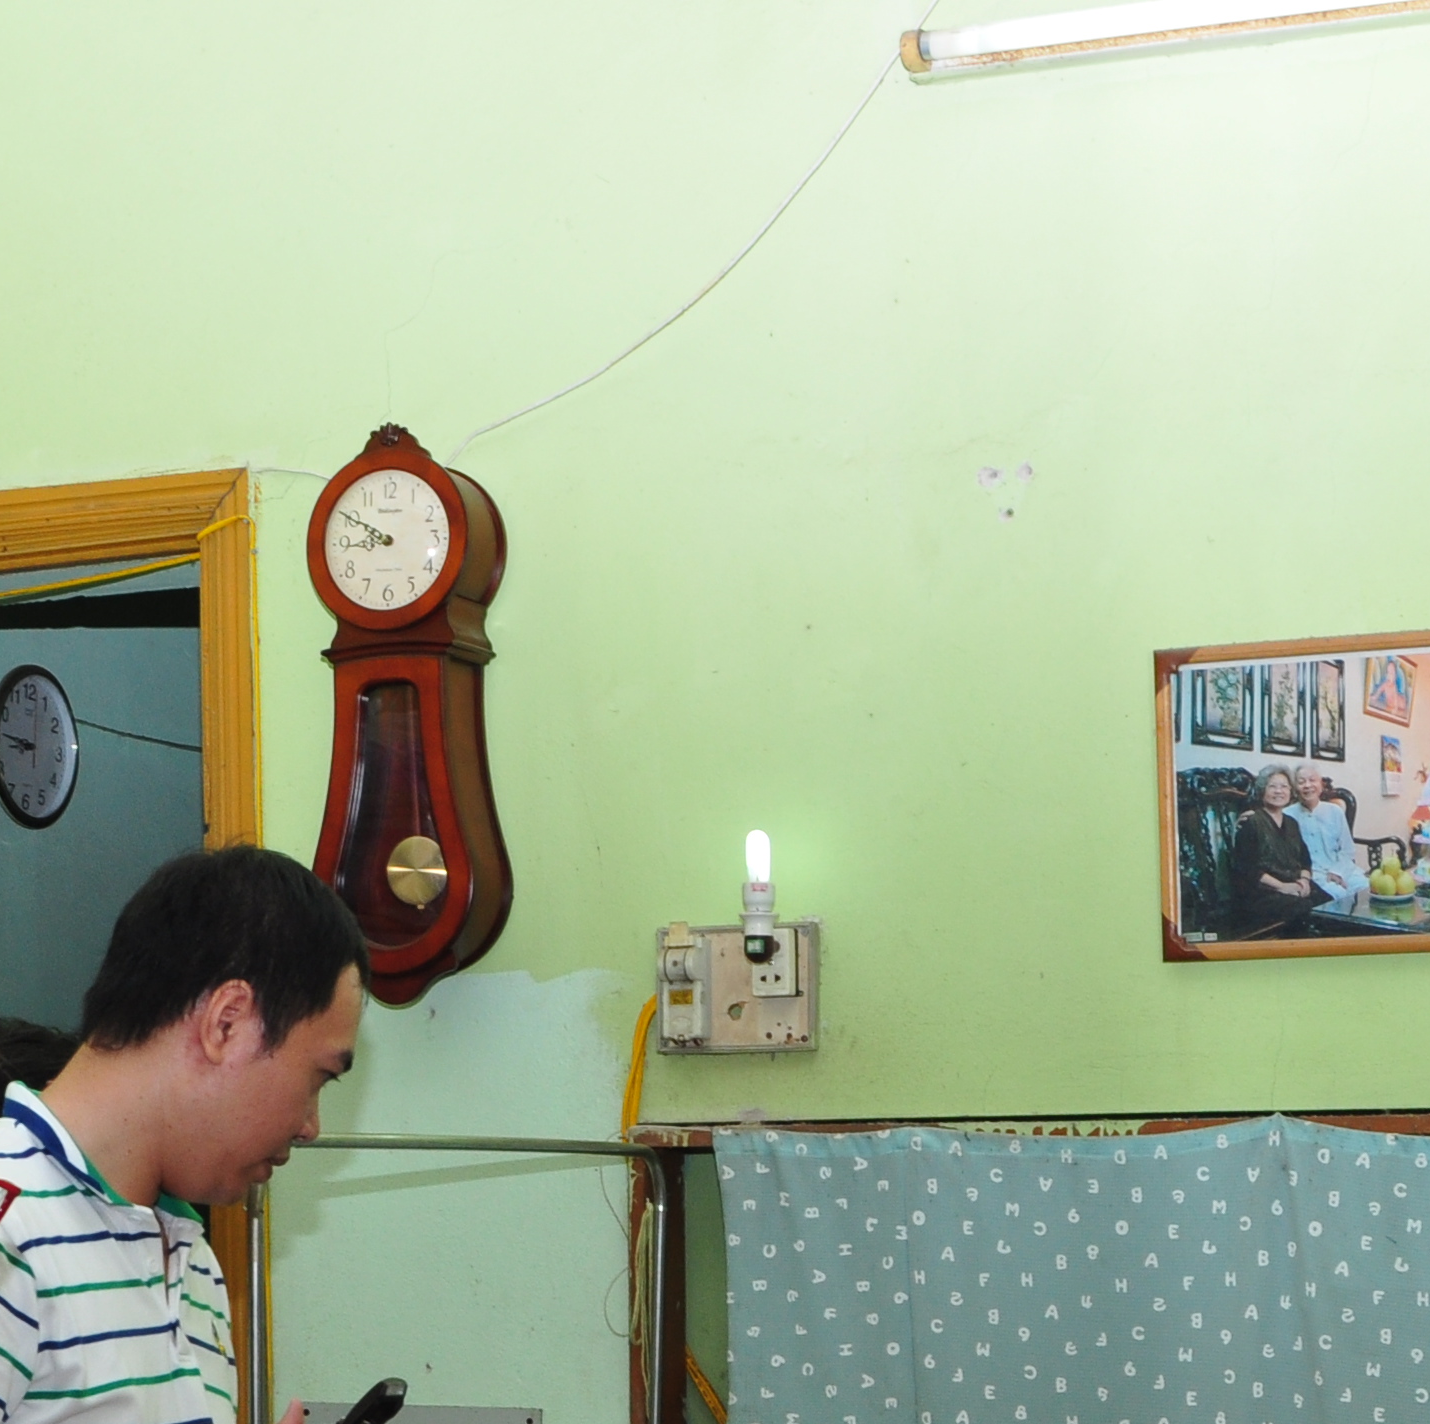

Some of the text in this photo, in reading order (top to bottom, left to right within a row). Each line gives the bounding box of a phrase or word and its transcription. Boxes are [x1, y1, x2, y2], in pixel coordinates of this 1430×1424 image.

[384, 481, 397, 499] 12
[363, 491, 373, 507] 11
[425, 505, 434, 522] 2
[339, 535, 350, 553] 9
[430, 529, 440, 548] 3
[345, 560, 355, 578] 8
[423, 558, 433, 574] 4
[362, 578, 371, 595] 7
[407, 577, 415, 593] 5
[382, 584, 394, 601] 6
[1268, 1129, 1280, 1146] H
[949, 1141, 962, 1156] A
[1154, 1145, 1167, 1159] A
[1061, 1149, 1072, 1163] H
[1356, 1153, 1370, 1168] A
[990, 1168, 1002, 1182] C
[1197, 1167, 1209, 1181] C
[1394, 1183, 1407, 1197] C
[1006, 1203, 1019, 1217] M
[1212, 1200, 1226, 1214] M
[963, 1221, 973, 1234] E
[1168, 1224, 1179, 1239] E
[1407, 1219, 1421, 1234] M
[1361, 1236, 1372, 1250] E
[942, 1247, 954, 1261] A
[1145, 1253, 1158, 1267] A
[1258, 1250, 1269, 1266] B
[1056, 1255, 1067, 1269] B
[1335, 1261, 1349, 1277] A
[914, 1271, 925, 1284] H
[980, 1273, 989, 1286] F
[1021, 1273, 1033, 1286] H
[1183, 1276, 1194, 1290] F
[1225, 1272, 1236, 1286] H
[1116, 1279, 1127, 1292] H
[1306, 1282, 1316, 1297] H
[1373, 1291, 1384, 1304] F
[1417, 1292, 1429, 1306] H
[1045, 1305, 1058, 1319] A
[1245, 1305, 1258, 1320] A
[931, 1319, 943, 1333] C
[1132, 1326, 1144, 1340] C
[1319, 1335, 1331, 1350] C
[1056, 1377, 1066, 1392] B
[1253, 1382, 1263, 1397] B
[984, 1385, 995, 1399] E
[1186, 1391, 1197, 1406] E
[956, 1410, 969, 1424] A
[1374, 1407, 1385, 1422] E
